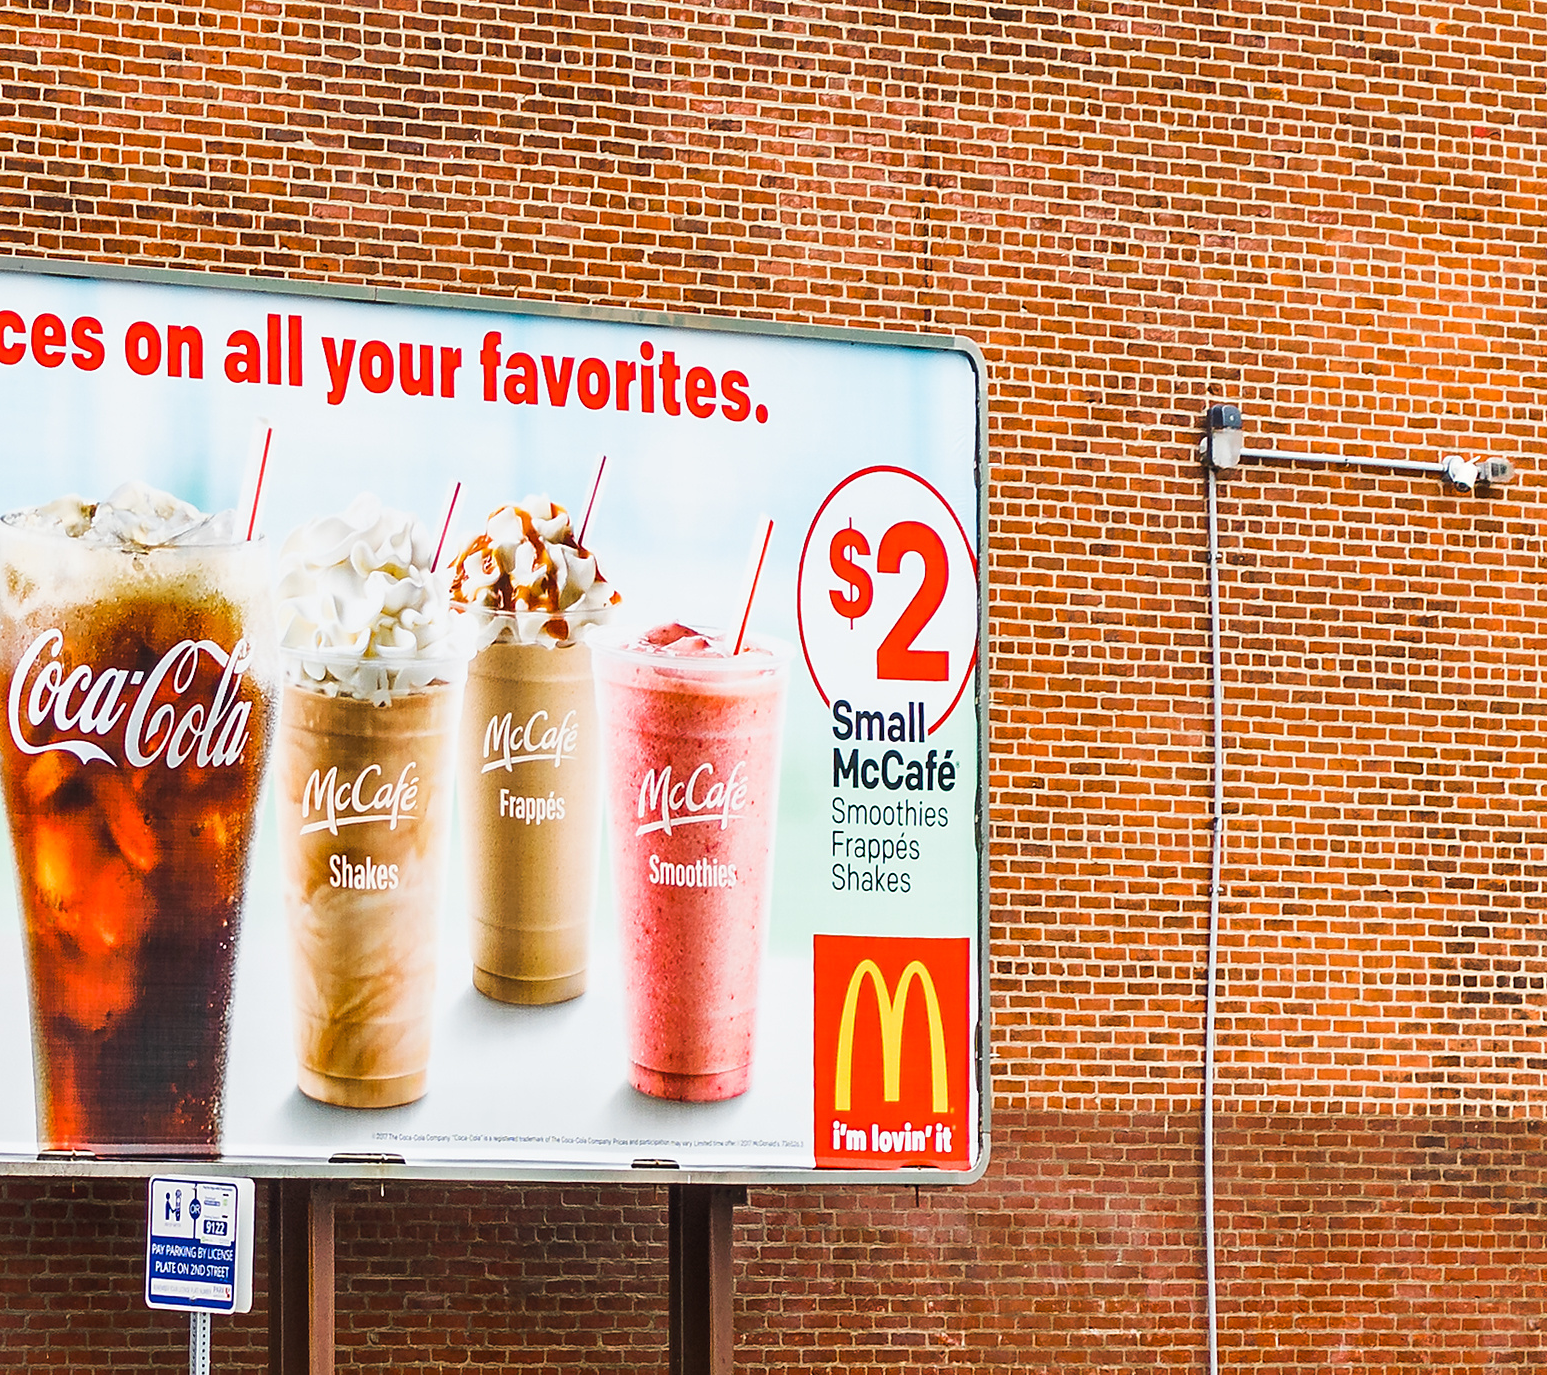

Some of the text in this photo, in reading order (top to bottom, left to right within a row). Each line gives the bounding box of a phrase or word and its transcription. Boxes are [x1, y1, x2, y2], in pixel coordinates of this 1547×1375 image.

[124, 320, 204, 380] on
[223, 313, 303, 387] all
[322, 335, 462, 405] your
[480, 328, 769, 424] favorites.
[829, 520, 951, 682] $2
[8, 628, 253, 768] Coca-Cola
[832, 699, 925, 742] Small
[833, 747, 956, 792] McCafé
[302, 762, 418, 826] McCafé
[499, 788, 565, 824] Frappés
[638, 762, 748, 828] McCafé
[831, 796, 949, 833] Smoothies
[832, 830, 920, 868] Frappés
[329, 855, 400, 891] Shakes
[649, 854, 737, 889] Smoothies
[831, 863, 911, 894] Shakes
[832, 1120, 955, 1153] i'm lovin' it
[190, 1204, 200, 1214] OR
[206, 1222, 225, 1234] 9122
[152, 1243, 233, 1262] PAY PARKING BY LICENSE
[155, 1261, 229, 1278] PLATE ON 2ND STREET
